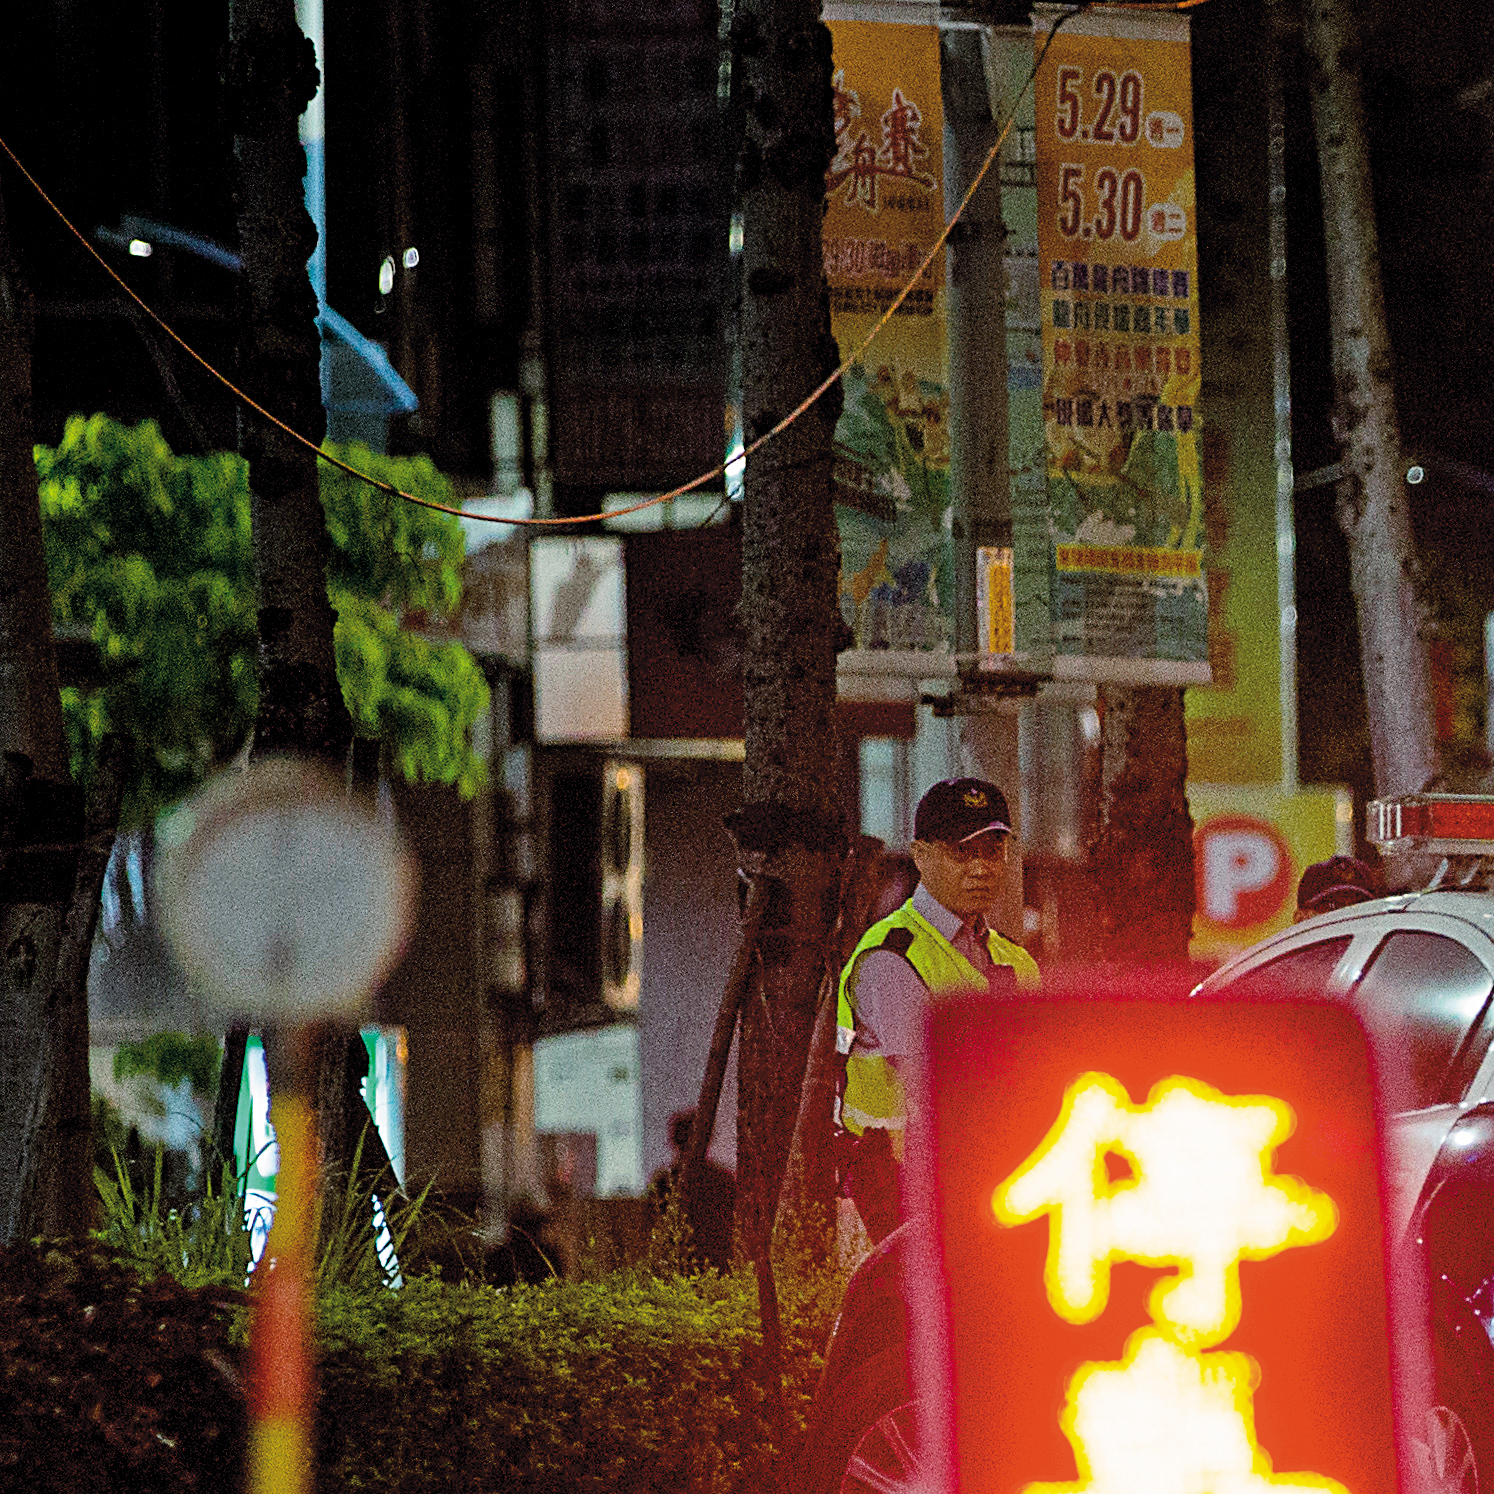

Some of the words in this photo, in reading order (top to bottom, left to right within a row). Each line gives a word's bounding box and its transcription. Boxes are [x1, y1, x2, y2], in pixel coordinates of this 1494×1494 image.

[1057, 67, 1143, 144] 5.29
[1059, 167, 1144, 241] 5.30
[1203, 830, 1278, 921] P
